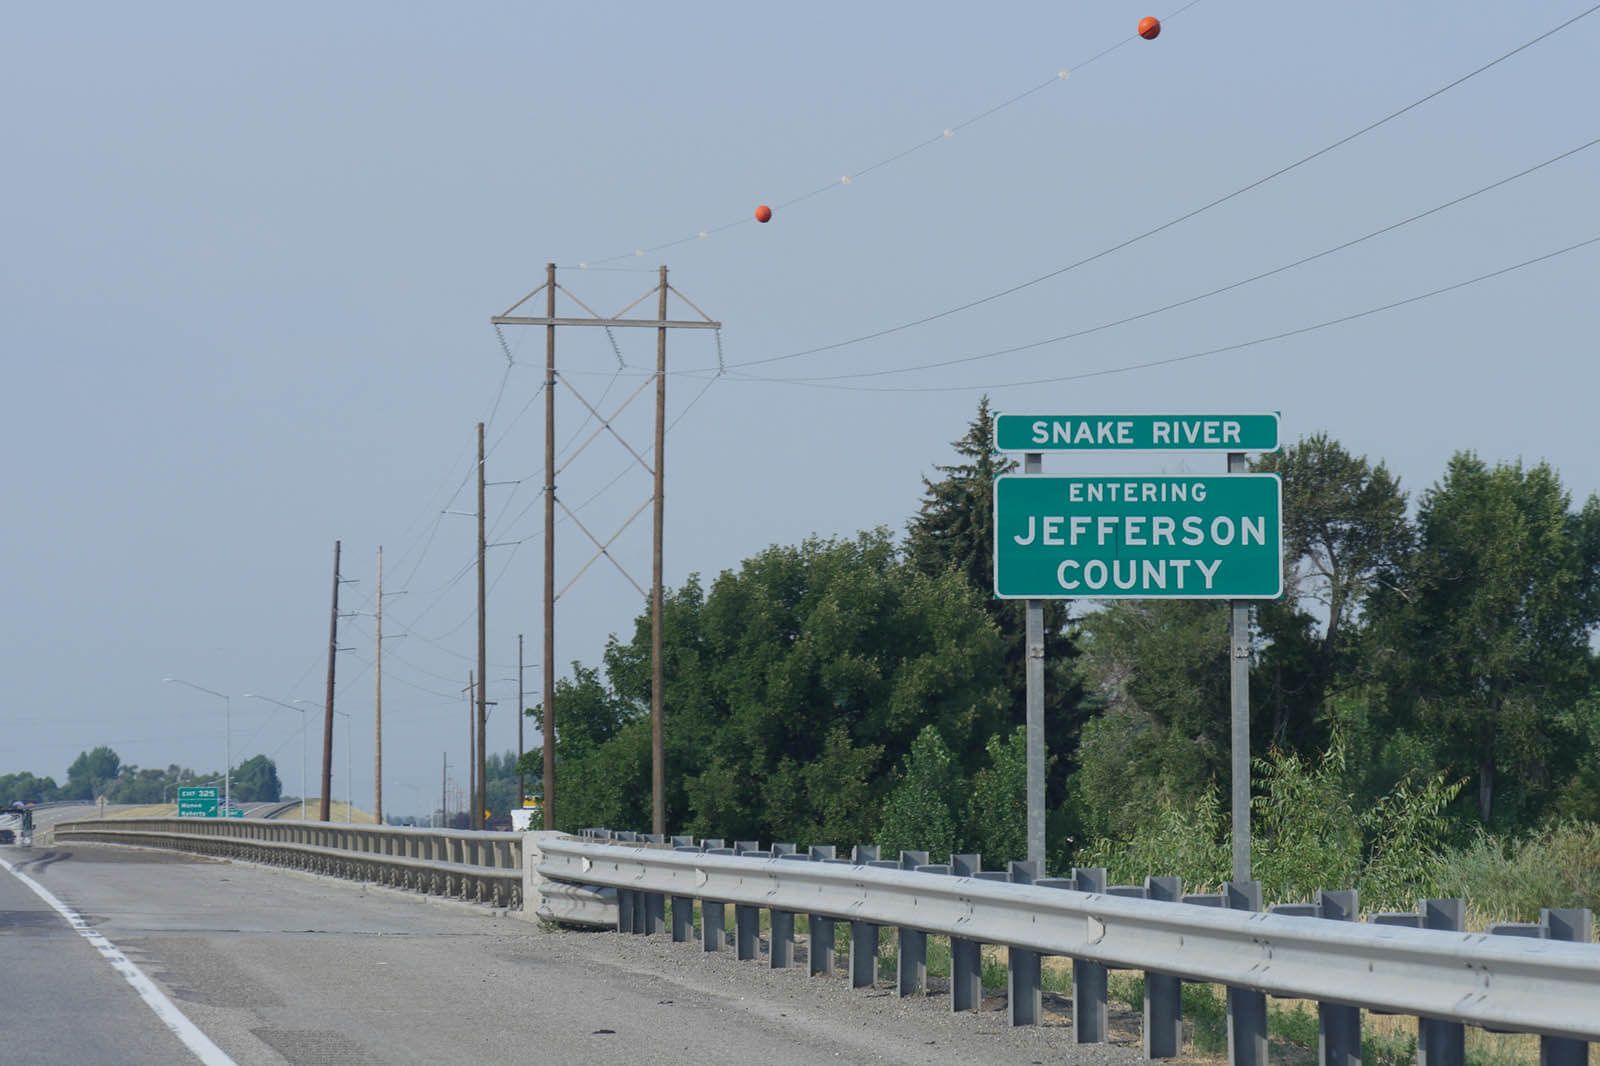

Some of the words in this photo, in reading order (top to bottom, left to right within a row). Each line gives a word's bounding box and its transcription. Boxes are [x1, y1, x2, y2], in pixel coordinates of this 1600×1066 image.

[1031, 421, 1134, 444] SNAKE
[1152, 421, 1241, 444] RIVER
[1069, 482, 1207, 502] ENTERING
[1013, 516, 1265, 546] JEFFERSON
[1057, 559, 1222, 590] COUNTY
